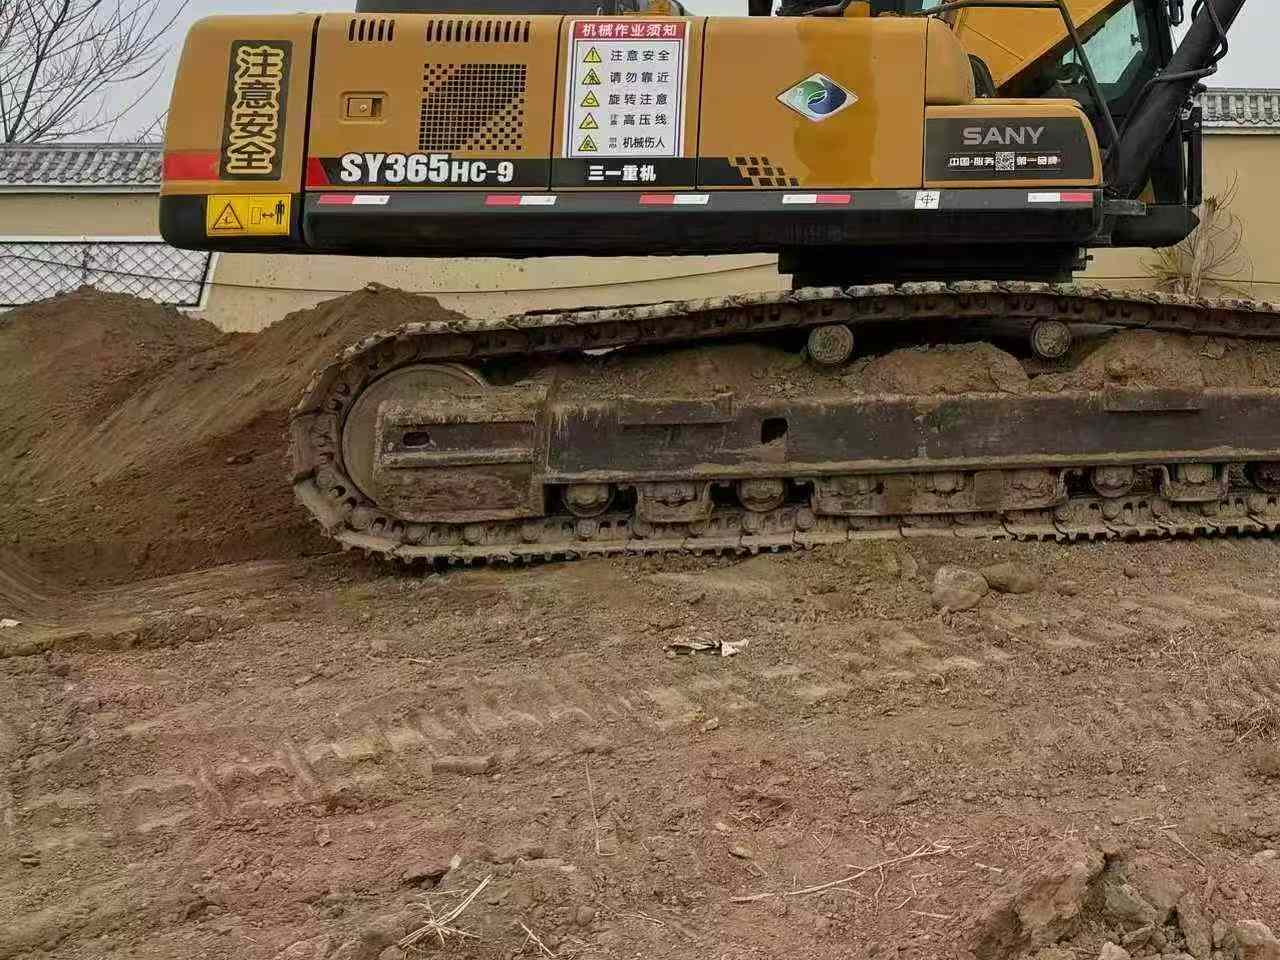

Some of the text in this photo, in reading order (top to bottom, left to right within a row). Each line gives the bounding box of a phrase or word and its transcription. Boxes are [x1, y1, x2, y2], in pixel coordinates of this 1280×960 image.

[583, 24, 676, 37] 机械作业须知
[610, 49, 670, 61] 注意安全
[609, 71, 669, 83] 请勿靠近
[608, 94, 668, 105] 旋转注意
[226, 46, 284, 173] 注意安全
[963, 126, 1044, 145] SANY
[340, 152, 514, 183] SY365HC-9
[588, 165, 656, 181] 三一重机
